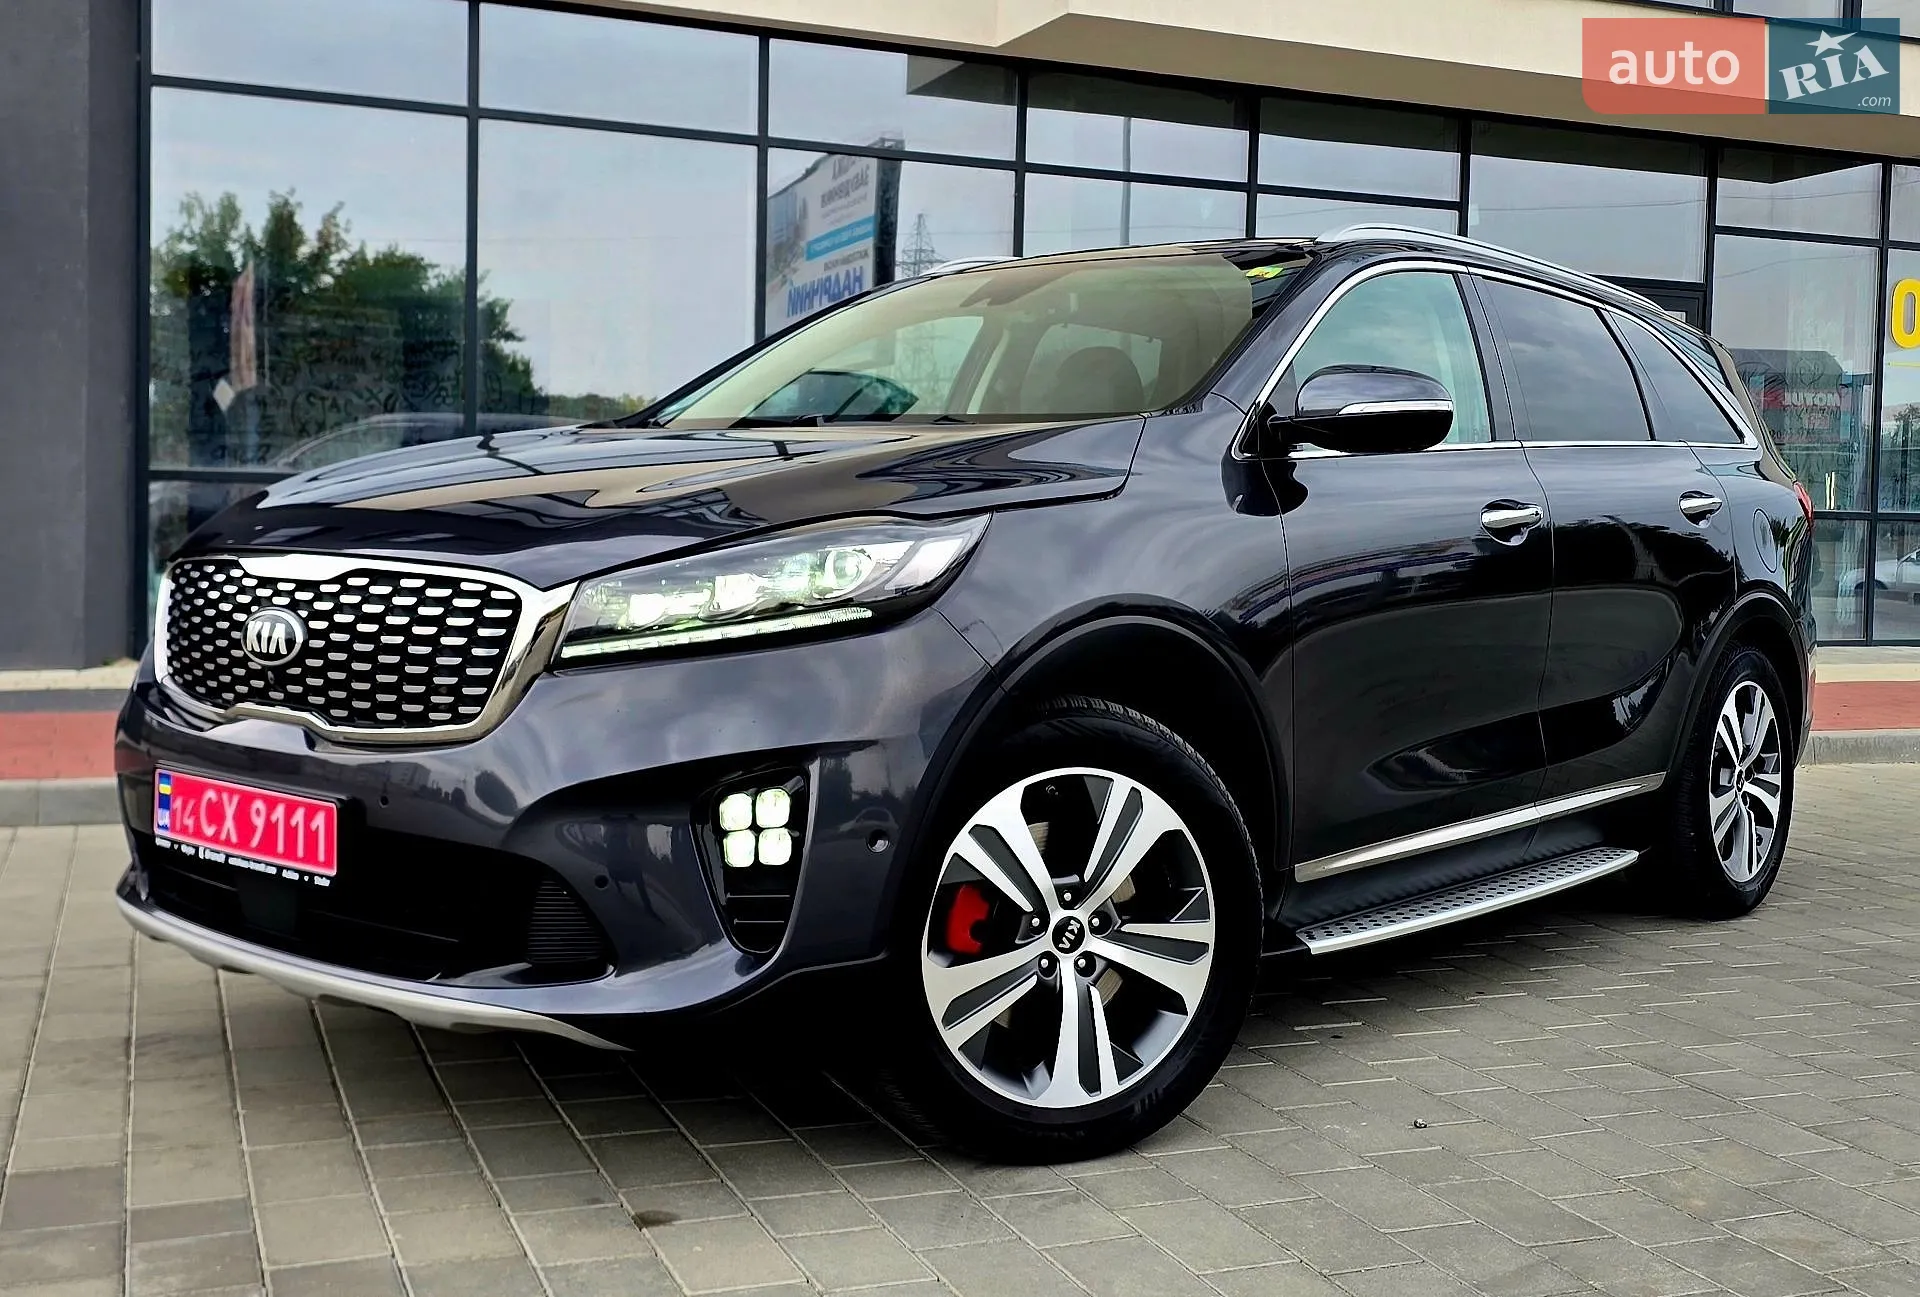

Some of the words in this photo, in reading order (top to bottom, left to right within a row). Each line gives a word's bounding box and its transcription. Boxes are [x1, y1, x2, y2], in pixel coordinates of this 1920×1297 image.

[246, 620, 288, 655] KIA
[249, 799, 326, 863] 9111
[1058, 919, 1081, 949] KIA
